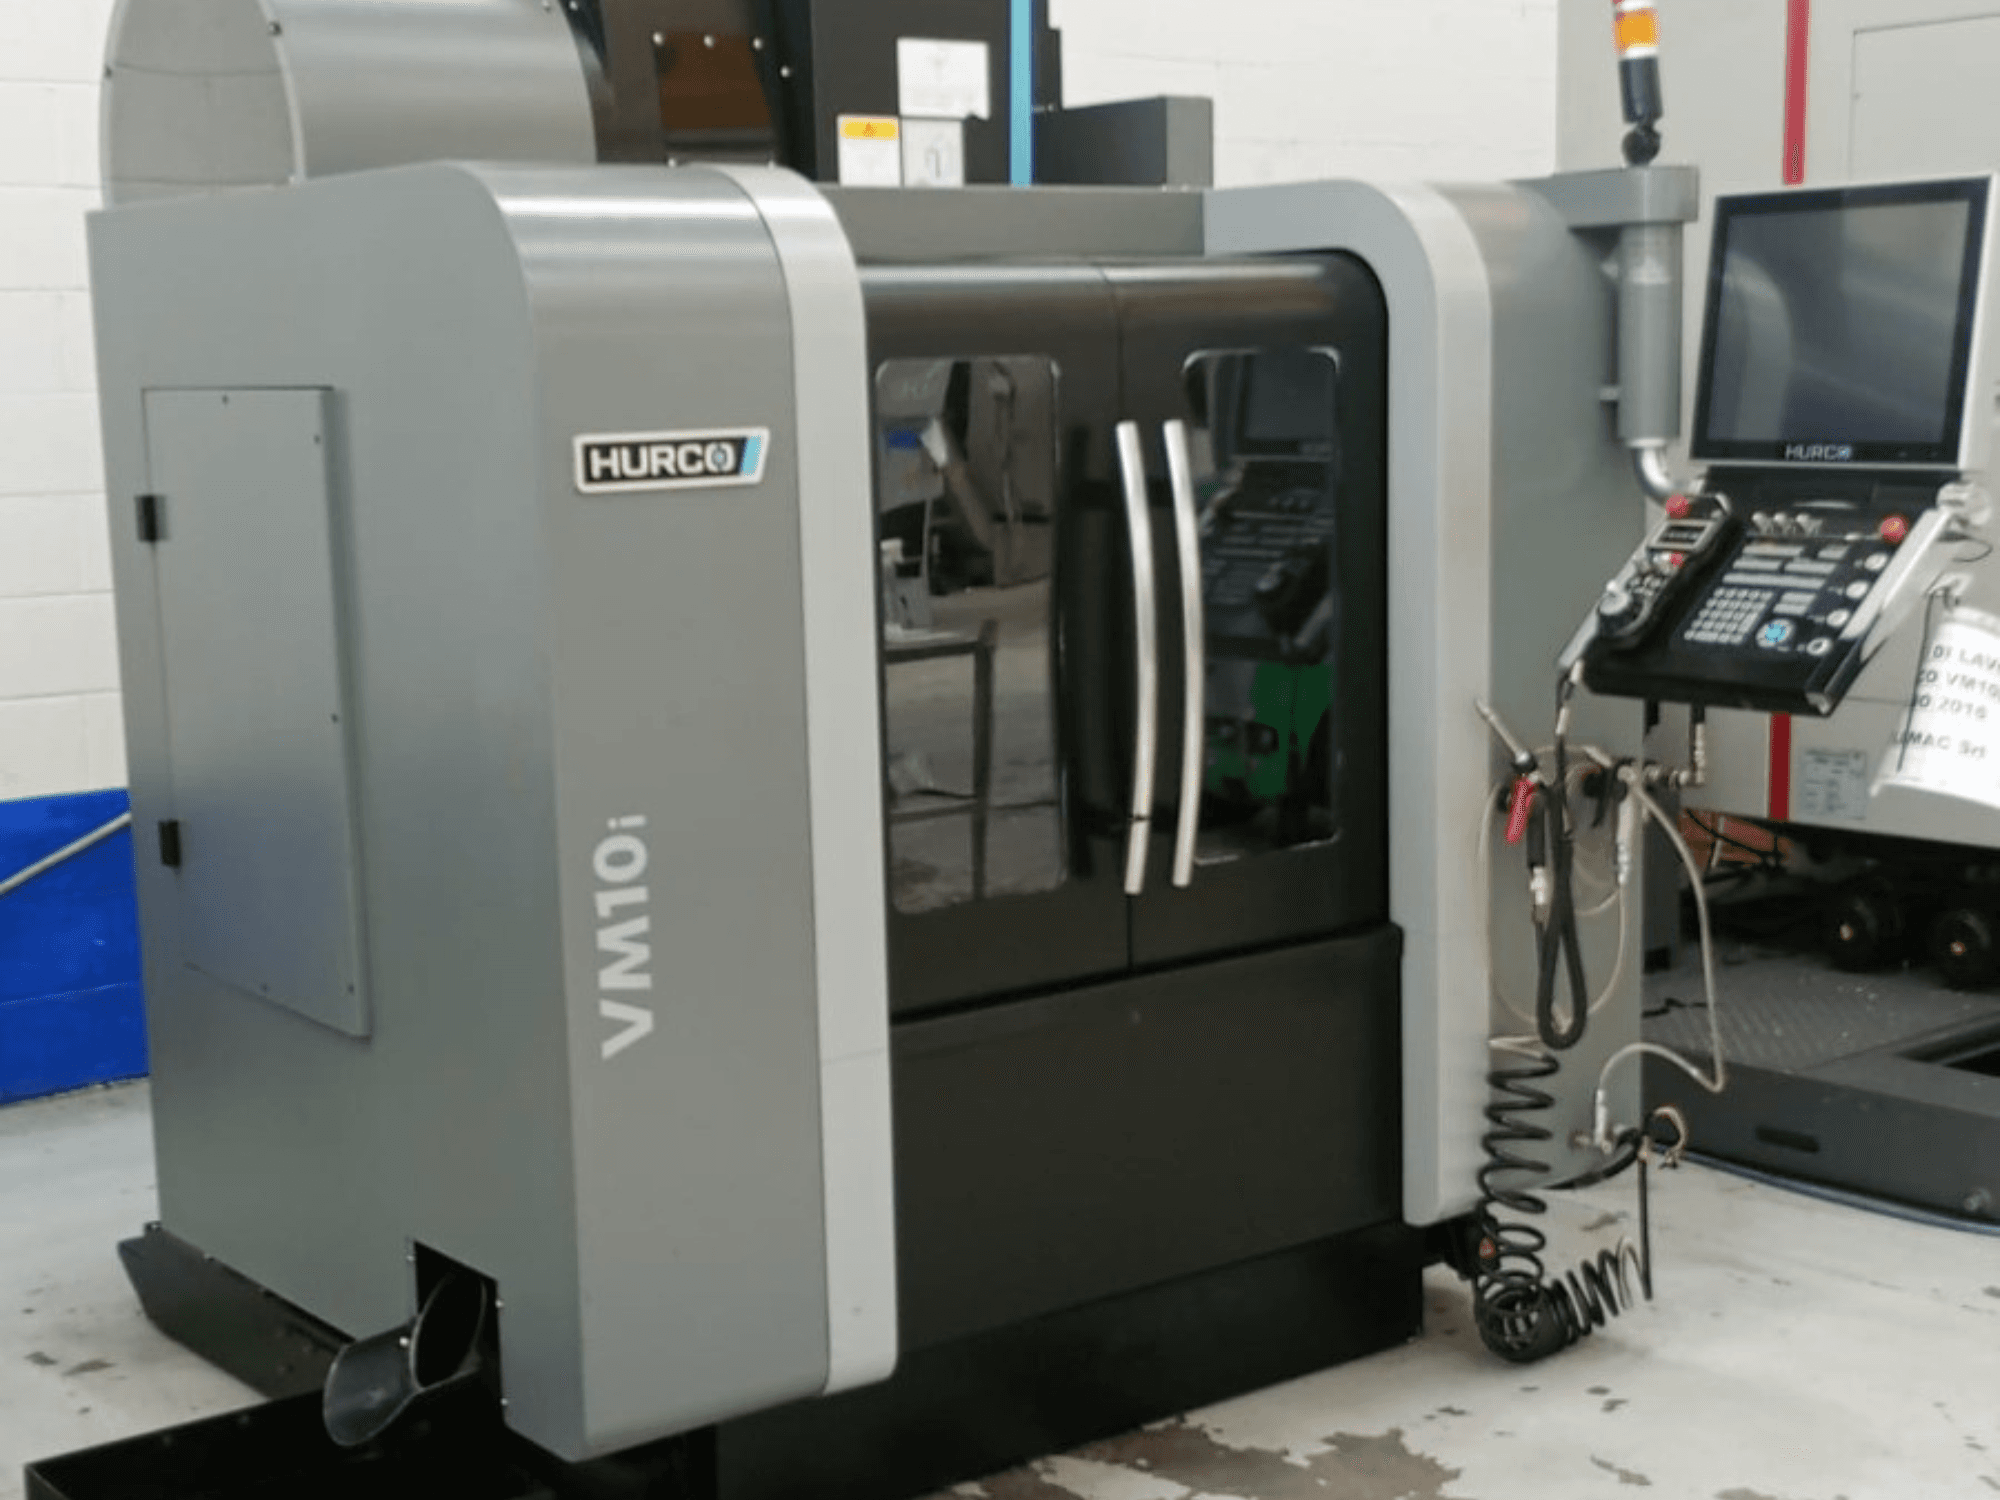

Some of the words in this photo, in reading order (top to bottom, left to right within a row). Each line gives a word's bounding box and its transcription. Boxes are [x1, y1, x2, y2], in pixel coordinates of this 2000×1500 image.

[589, 441, 737, 479] HURCO
[1784, 443, 1853, 461] HURCO
[1958, 648, 2000, 673] LAV
[592, 814, 655, 1061] VM10i
